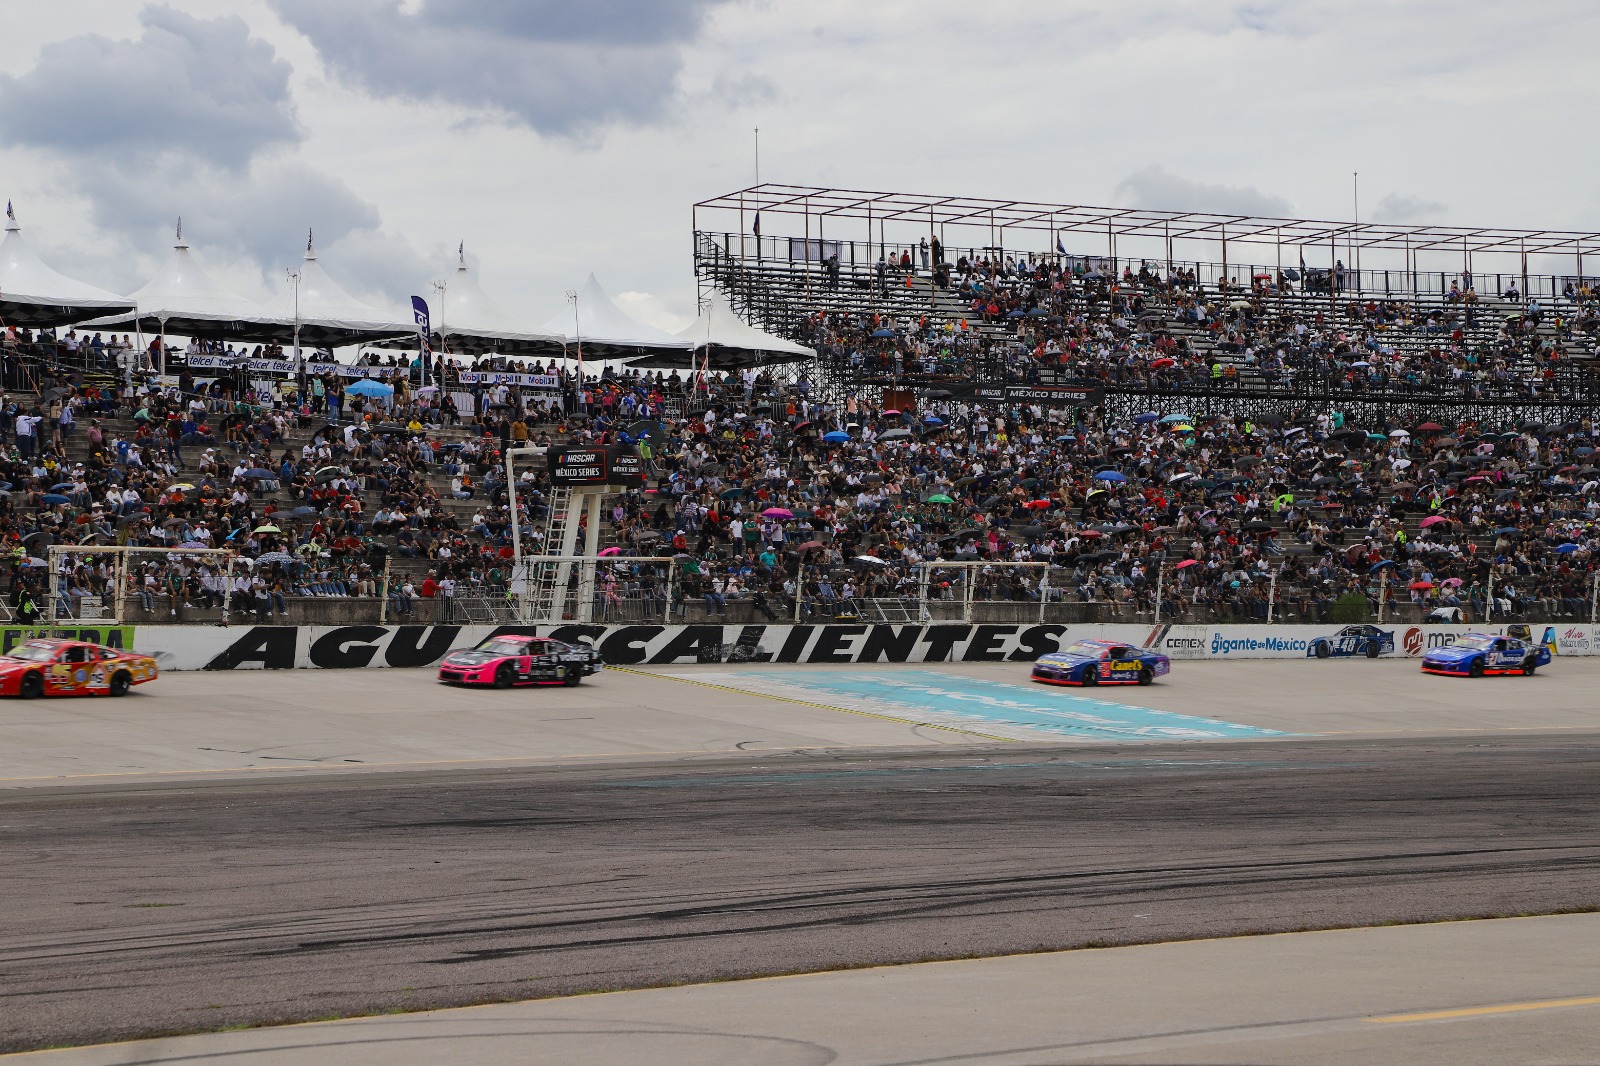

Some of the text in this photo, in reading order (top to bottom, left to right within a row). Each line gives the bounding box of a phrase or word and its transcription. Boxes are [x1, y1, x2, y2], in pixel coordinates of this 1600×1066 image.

[189, 356, 214, 366] telcel
[272, 361, 297, 372] telcel
[346, 367, 371, 377] telcel
[460, 373, 480, 381] Mobil
[980, 388, 1087, 400] NASCAR MÉXICO SERIES
[566, 453, 596, 464] NASCAR
[555, 467, 600, 477] MÉXICO SERIES
[1214, 632, 1221, 640] El
[1166, 638, 1206, 649] CEMEX
[1211, 636, 1307, 654] gigante de México
[1340, 637, 1356, 653] 48
[1109, 658, 1143, 671] Canel's
